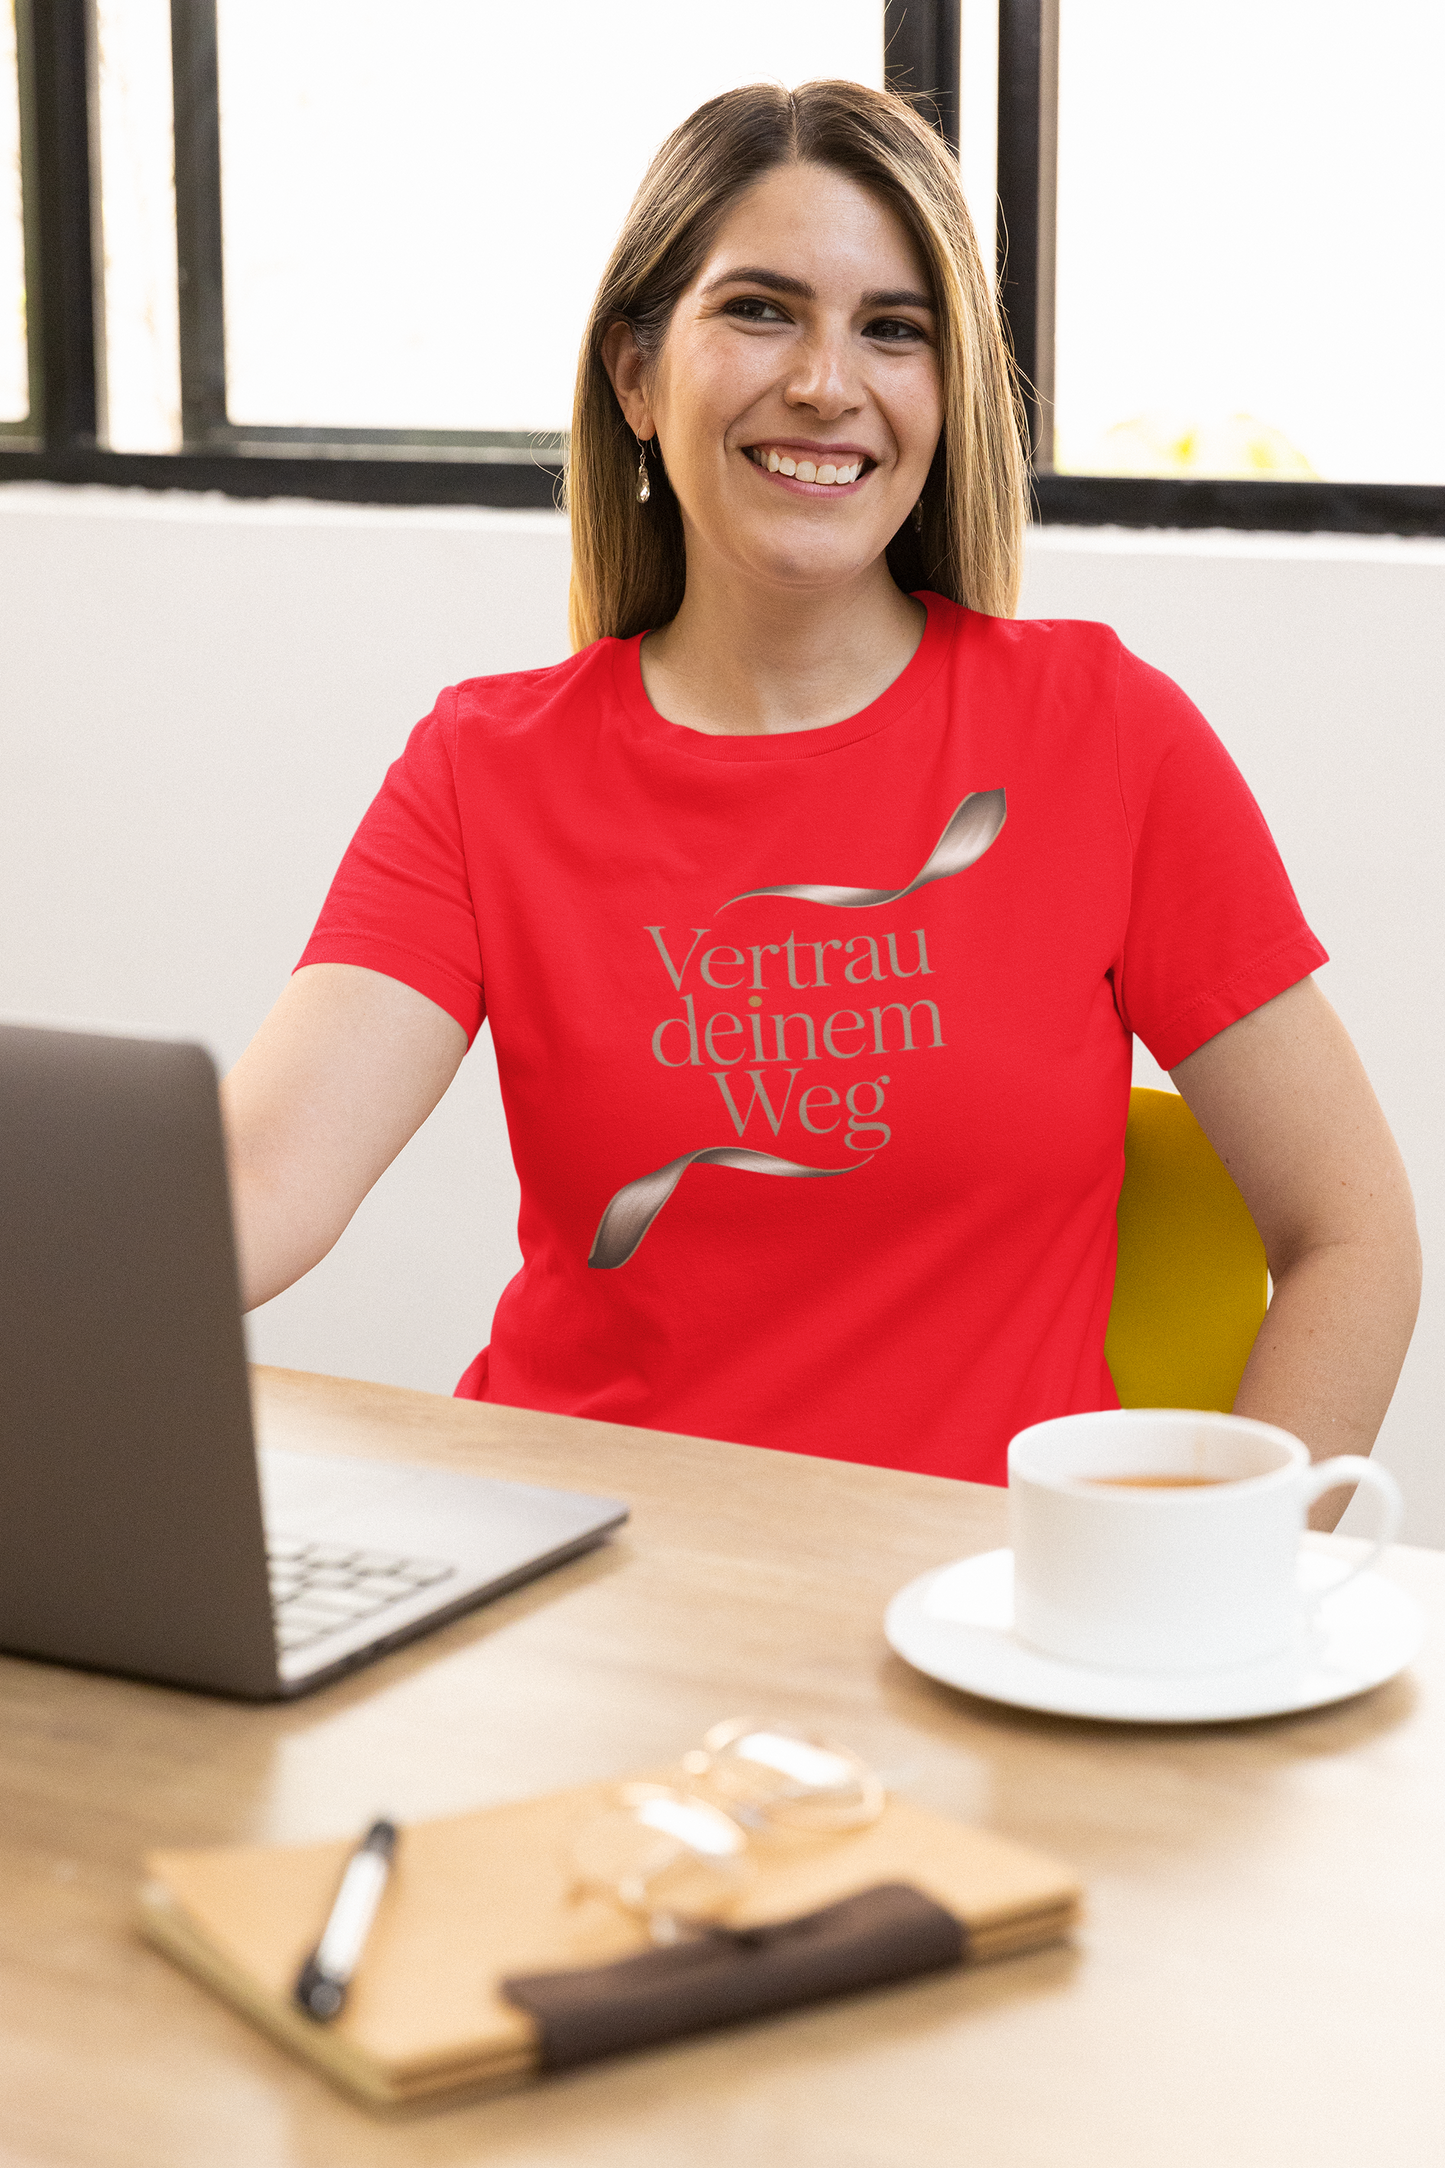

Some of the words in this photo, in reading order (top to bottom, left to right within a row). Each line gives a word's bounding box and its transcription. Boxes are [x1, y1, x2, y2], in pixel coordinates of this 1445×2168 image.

[644, 926, 935, 991] Vertrau
[651, 994, 948, 1067] deinem
[709, 1067, 891, 1151] Weg
